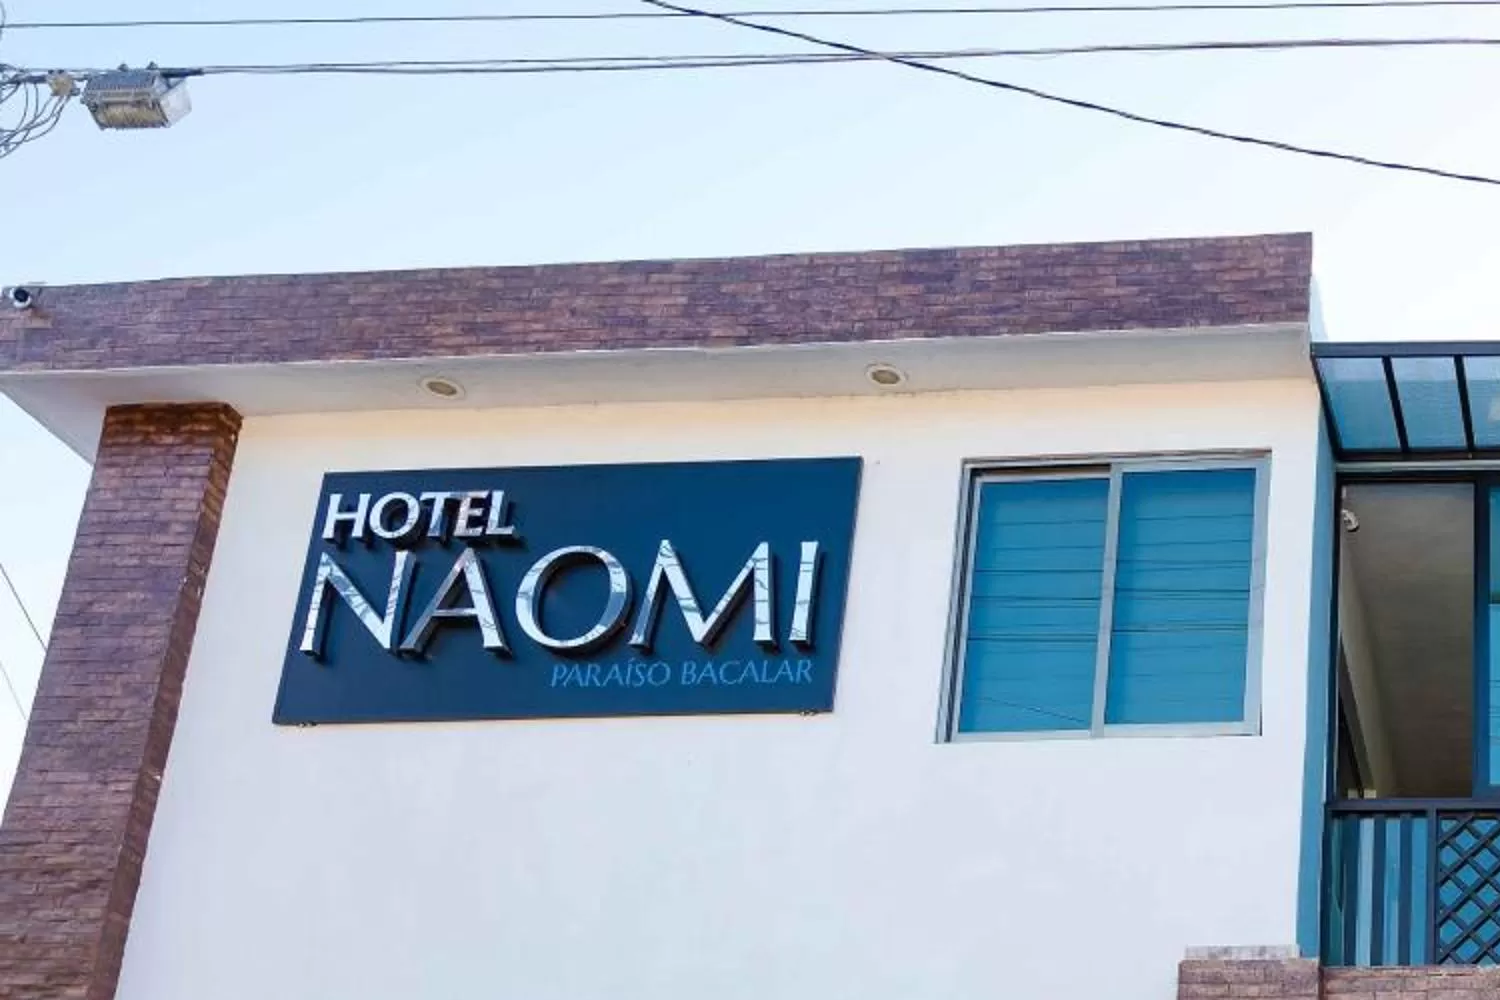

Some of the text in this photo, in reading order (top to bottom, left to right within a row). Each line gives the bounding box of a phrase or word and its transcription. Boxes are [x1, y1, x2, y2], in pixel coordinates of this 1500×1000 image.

[321, 489, 516, 540] HOTEL
[300, 539, 822, 655] NAOMI
[550, 657, 814, 688] PARAÍSO BACALAR
